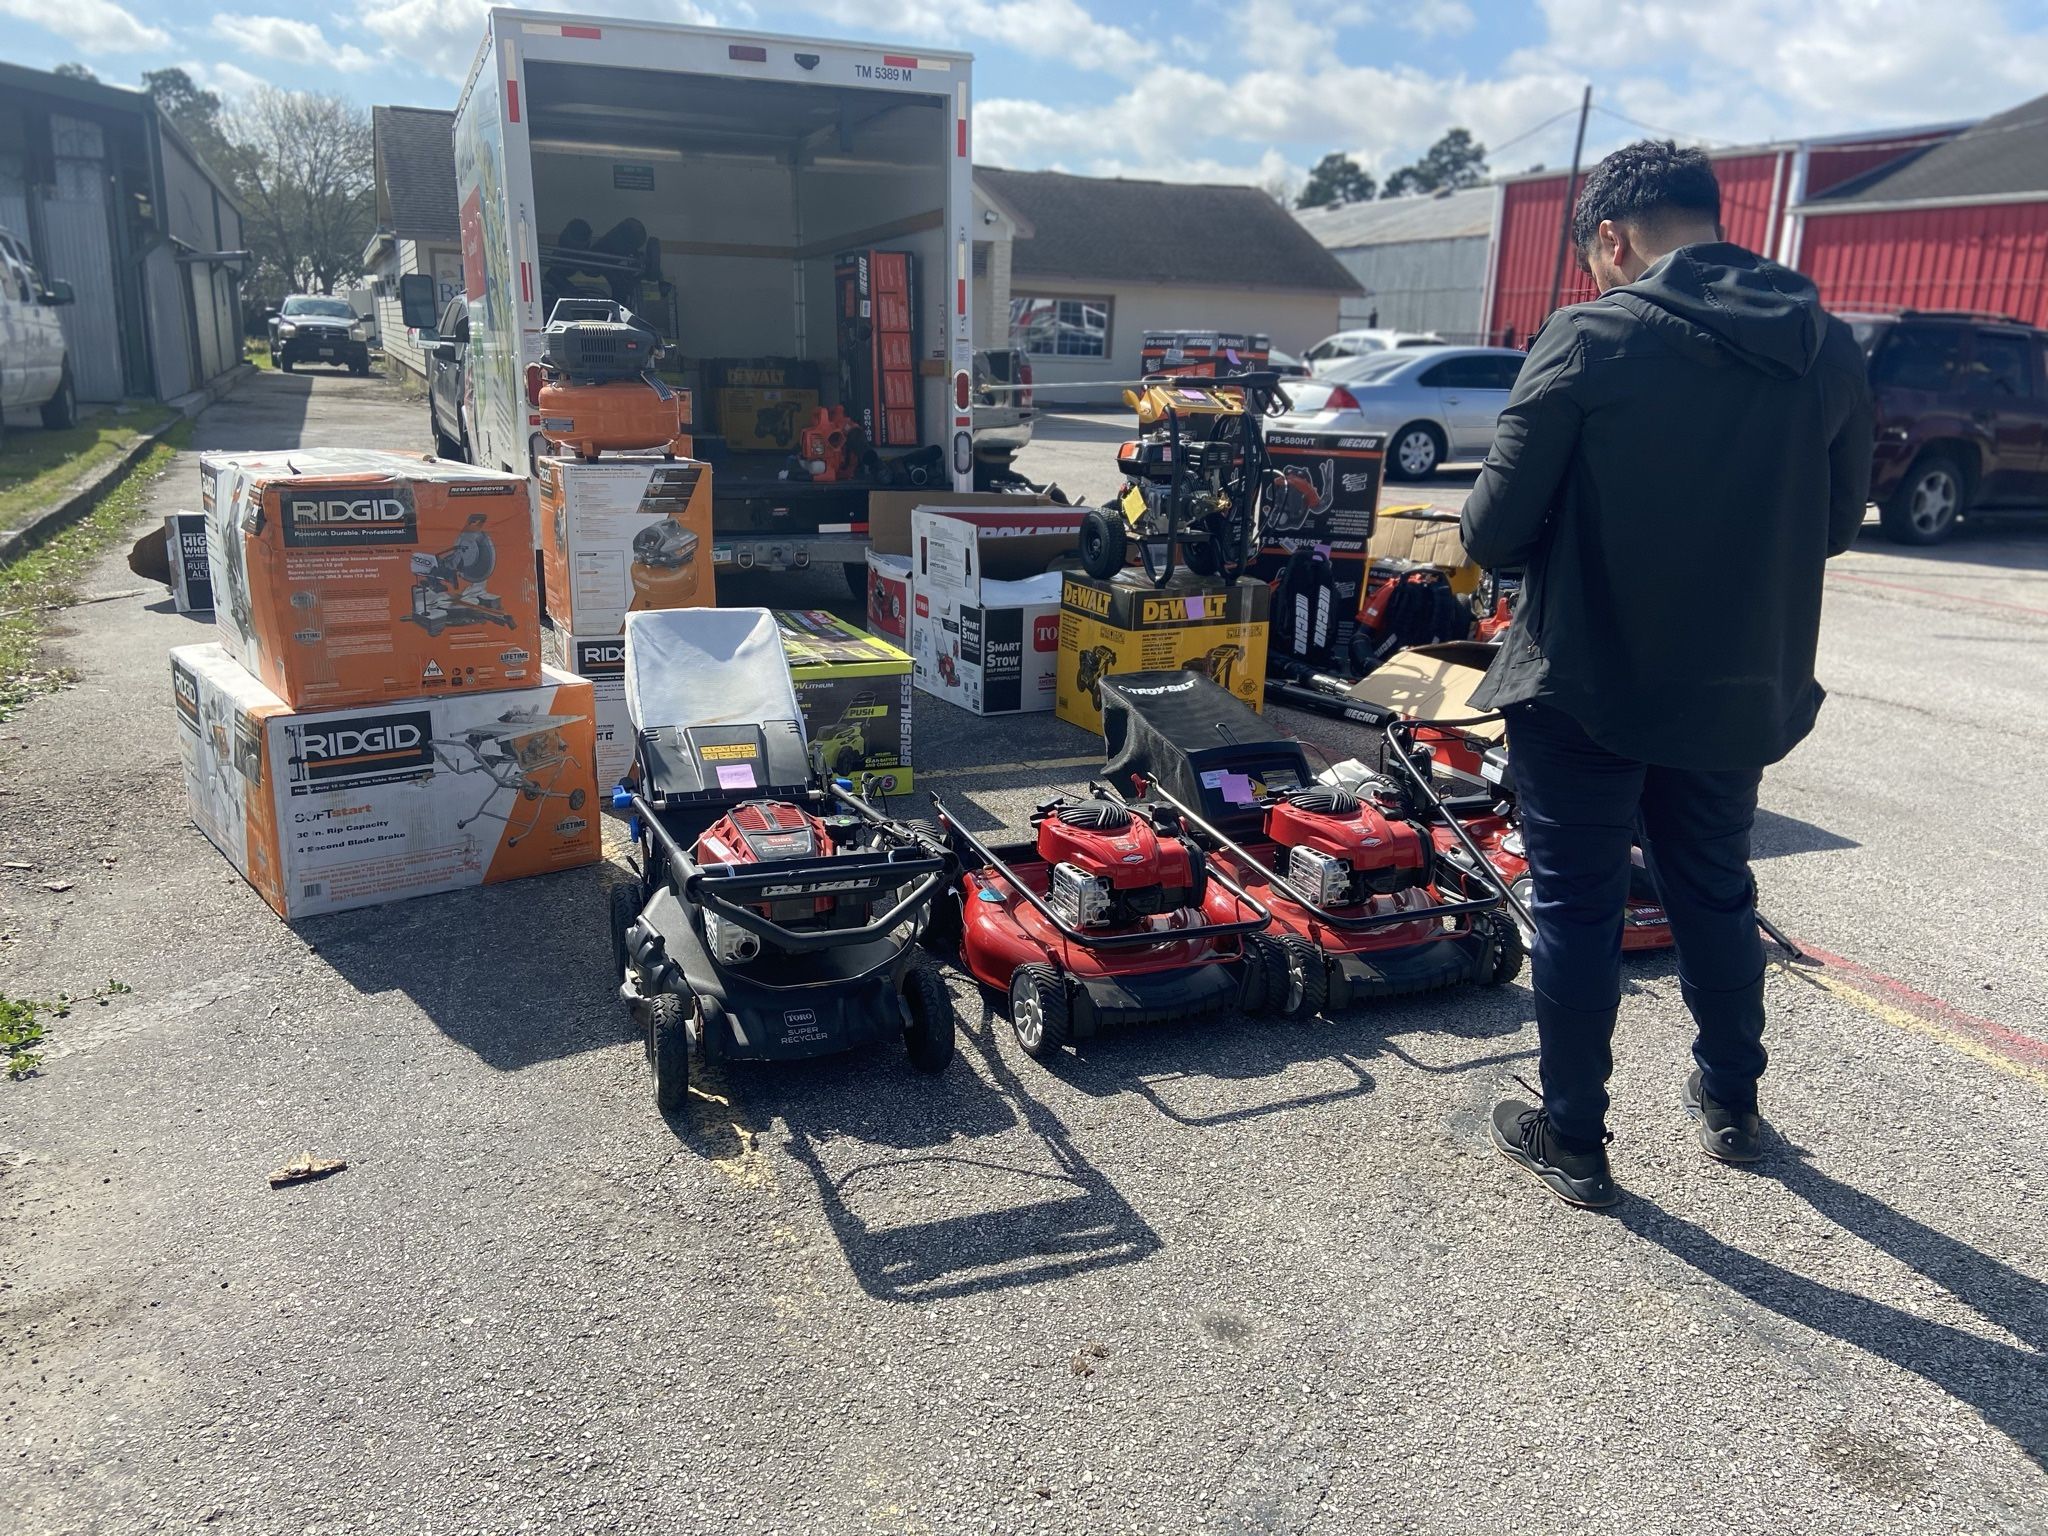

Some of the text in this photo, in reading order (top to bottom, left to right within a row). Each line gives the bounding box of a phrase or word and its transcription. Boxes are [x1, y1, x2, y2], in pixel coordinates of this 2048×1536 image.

[855, 65, 912, 82] TM 5389 M
[859, 257, 868, 292] ECHO
[1269, 436, 1316, 446] PB-580H/T
[1340, 438, 1378, 448] ECHO
[292, 499, 405, 521] RIDGID
[330, 528, 361, 537] Durable.
[361, 527, 405, 536] Professional.
[1331, 540, 1363, 550] ECHO
[1143, 599, 1226, 622] DEWLT
[1314, 585, 1331, 648] ECHO
[962, 616, 980, 631] SMART
[1294, 593, 1309, 655] ECHO
[962, 628, 979, 643] STOW
[986, 640, 1021, 653] SMART
[500, 652, 529, 661] LIFETIME
[986, 654, 1019, 668] STOW
[1122, 679, 1198, 696] TROY-BILT
[850, 708, 874, 717] PUSH
[1346, 709, 1379, 724] ECHO
[900, 674, 912, 766] BRUSHLESS
[302, 724, 421, 758] RIDGID
[327, 825, 344, 836] Rip
[346, 819, 390, 832] Capacity
[556, 819, 586, 831] LIFETIME
[347, 836, 376, 846] Blade
[377, 832, 406, 843] Brake
[786, 1012, 813, 1022] TORO
[780, 1032, 828, 1044] RECYCLER
[787, 1026, 819, 1036] SUPER
